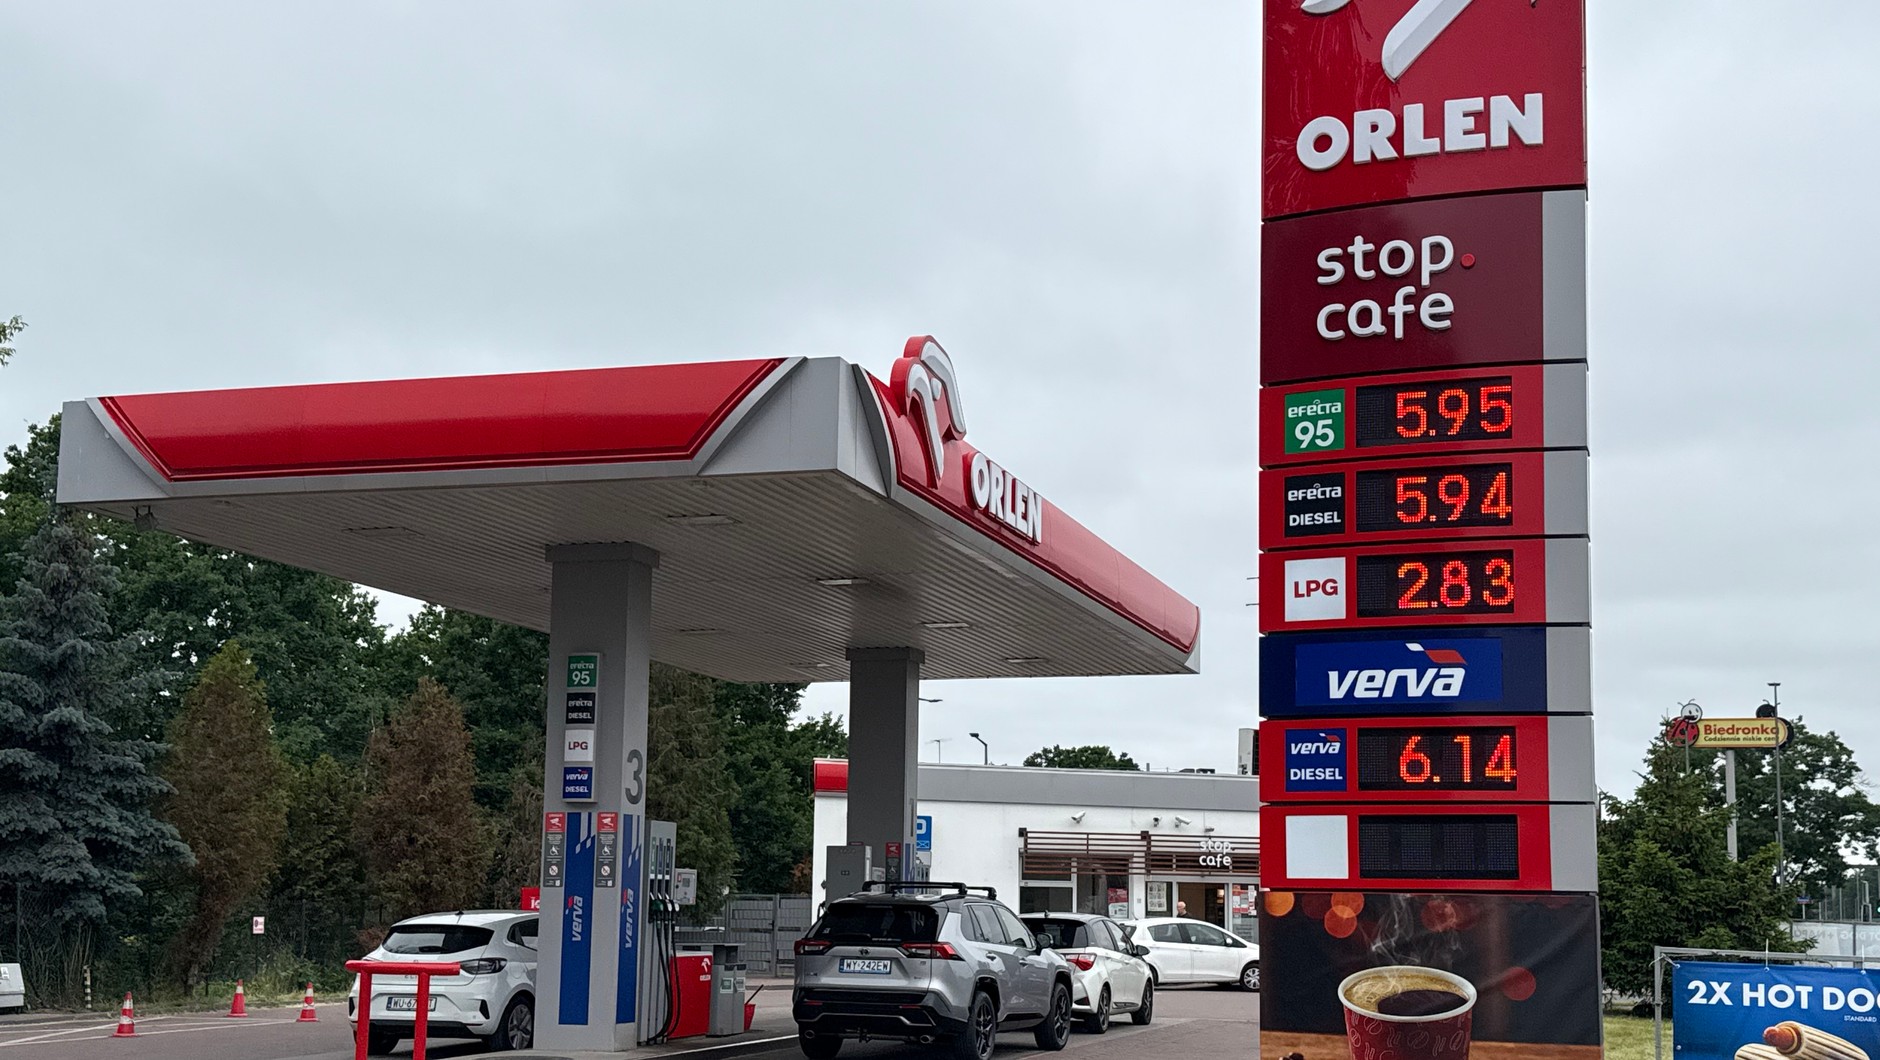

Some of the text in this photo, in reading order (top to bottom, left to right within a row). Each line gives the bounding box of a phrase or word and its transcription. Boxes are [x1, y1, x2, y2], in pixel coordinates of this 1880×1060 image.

[1296, 93, 1544, 171] ORLEN
[1316, 286, 1455, 340] cafe
[1396, 386, 1512, 438] 5.95
[1294, 419, 1335, 449] 95
[970, 452, 1043, 544] ORLEN
[1396, 472, 1512, 523] 5.94
[1289, 511, 1342, 527] DIESEL
[1293, 578, 1339, 599] LPG
[1398, 558, 1515, 609] 2.83
[572, 671, 590, 685] 95
[1327, 667, 1466, 699] verva
[568, 741, 588, 750] LPG
[1290, 741, 1341, 755] verva
[1400, 735, 1517, 783] 6.14
[565, 785, 589, 793] DIESEL
[625, 749, 643, 804] 3
[1290, 767, 1343, 781] DIESEL
[1199, 854, 1232, 867] cafe
[571, 895, 583, 941] verva
[624, 888, 634, 948] verva
[1687, 980, 1734, 1006] 2X
[1742, 983, 1813, 1009] HOT
[1843, 1015, 1877, 1023] STANDARD
